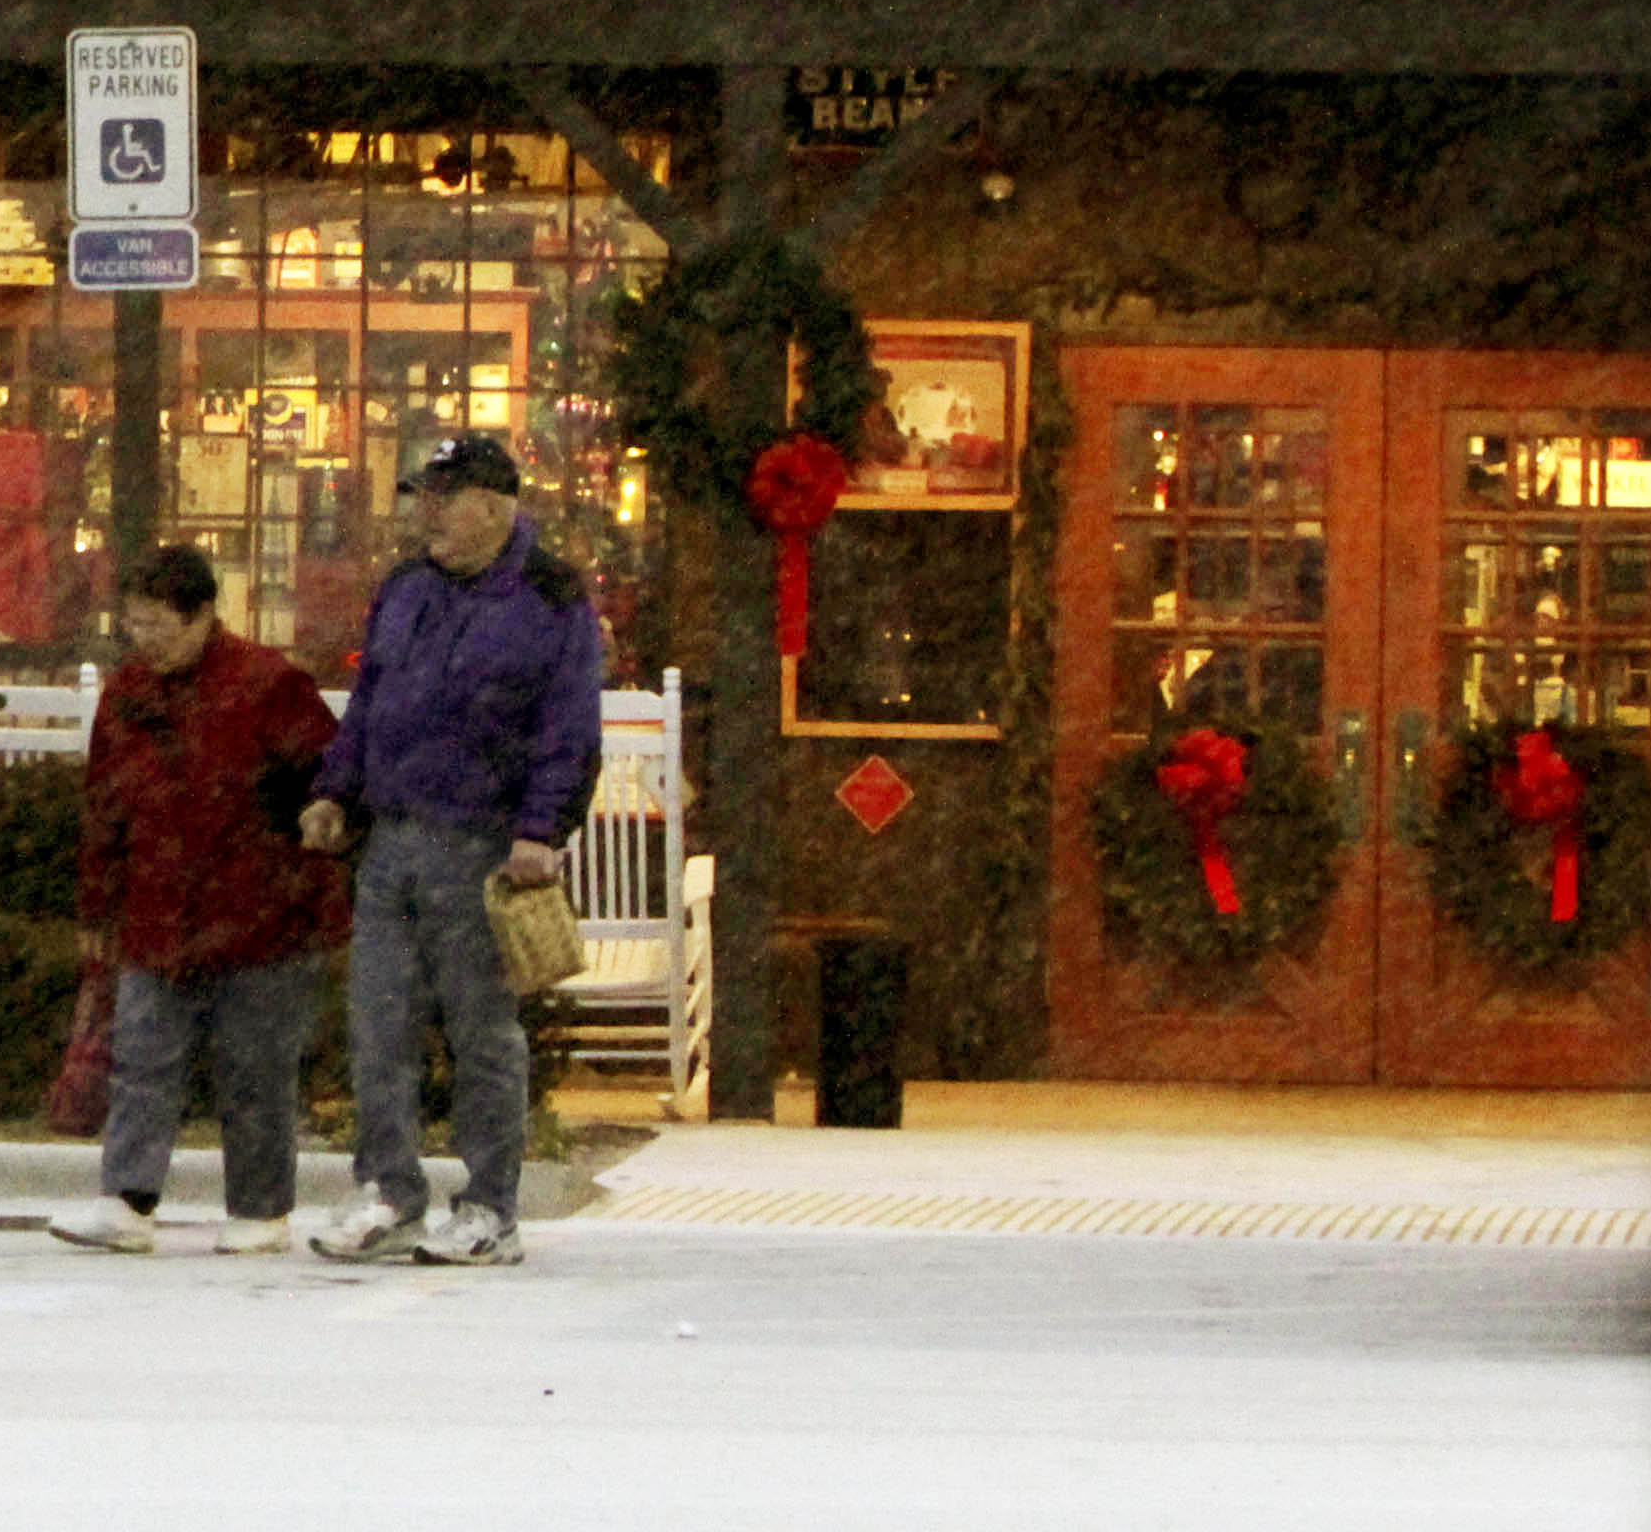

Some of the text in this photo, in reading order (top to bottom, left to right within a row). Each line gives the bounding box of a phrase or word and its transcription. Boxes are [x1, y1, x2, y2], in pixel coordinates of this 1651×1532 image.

[79, 45, 185, 70] RESERVED
[88, 75, 178, 98] PARKING
[116, 237, 153, 253] VAN
[80, 261, 188, 277] ACCESSIBLE
